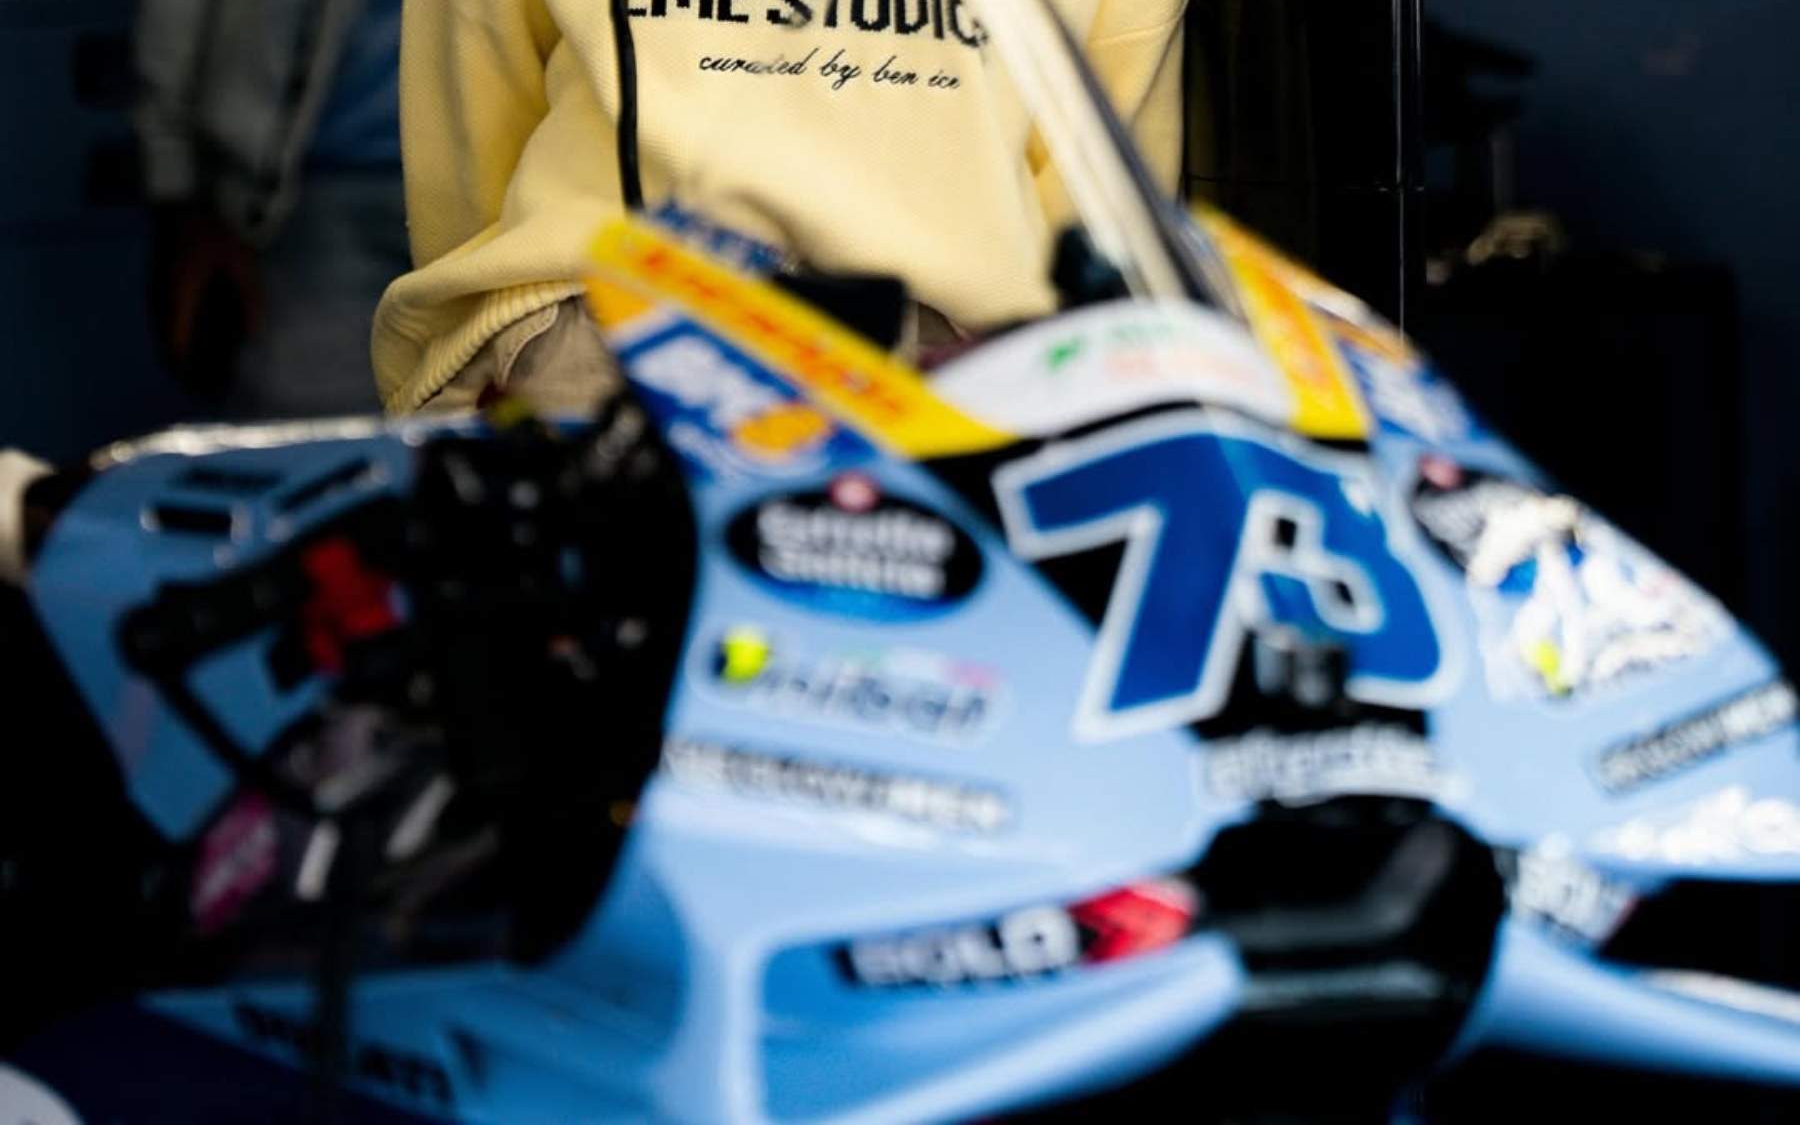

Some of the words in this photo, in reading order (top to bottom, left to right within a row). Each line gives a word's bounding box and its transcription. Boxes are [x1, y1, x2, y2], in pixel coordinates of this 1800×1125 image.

[820, 49, 861, 90] by
[873, 55, 919, 85] ben
[994, 415, 1458, 737] 73
